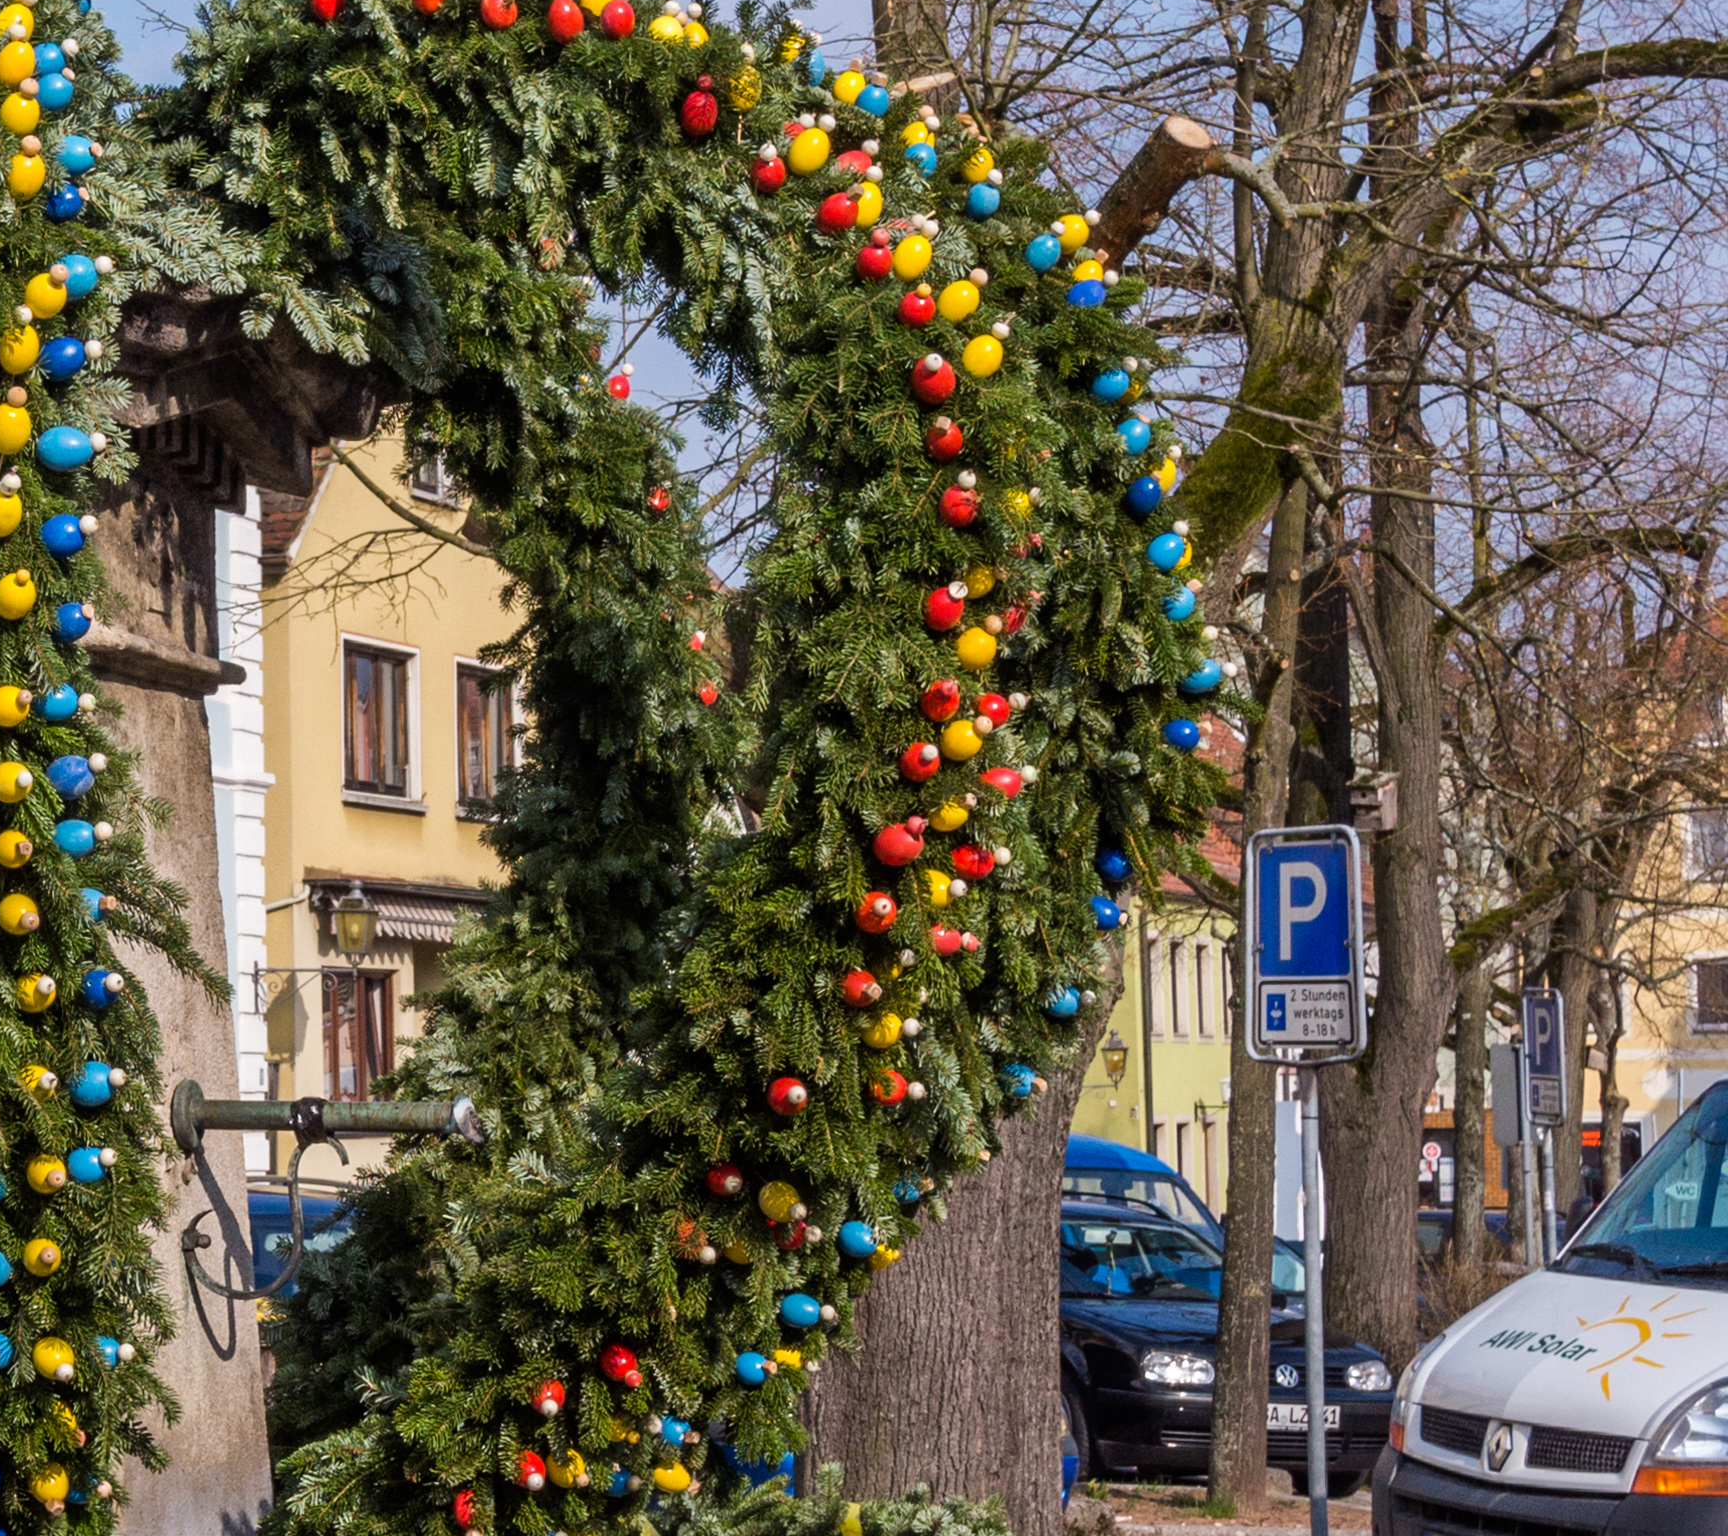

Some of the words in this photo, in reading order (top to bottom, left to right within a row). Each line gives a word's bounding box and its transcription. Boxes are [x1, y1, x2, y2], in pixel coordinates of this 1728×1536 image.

[1279, 861, 1327, 961] P
[1290, 989, 1296, 1002] 2
[1301, 988, 1346, 1002] Stunden
[1293, 1006, 1345, 1022] werktags
[1534, 1007, 1551, 1066] P
[1675, 1185, 1695, 1196] WC
[1479, 1329, 1538, 1350] AWI
[1527, 1334, 1597, 1361] Solar
